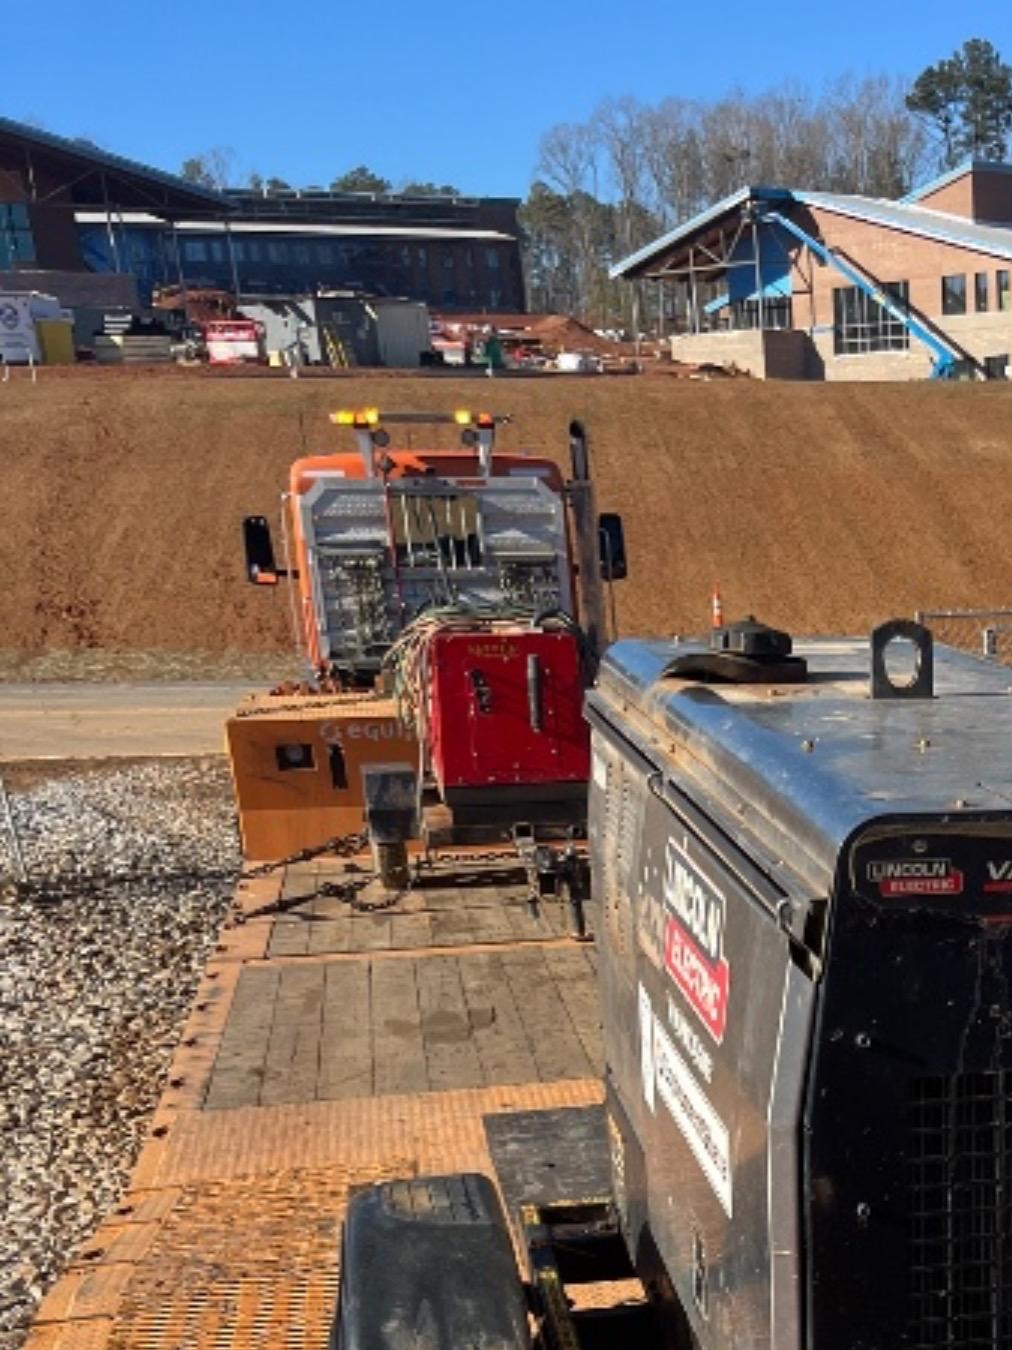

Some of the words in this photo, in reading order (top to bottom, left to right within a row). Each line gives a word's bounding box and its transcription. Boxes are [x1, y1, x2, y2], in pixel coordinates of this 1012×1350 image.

[872, 862, 947, 878] LINCOLN
[889, 878, 956, 893] ELECTRIC
[664, 848, 723, 960] LINCOLN
